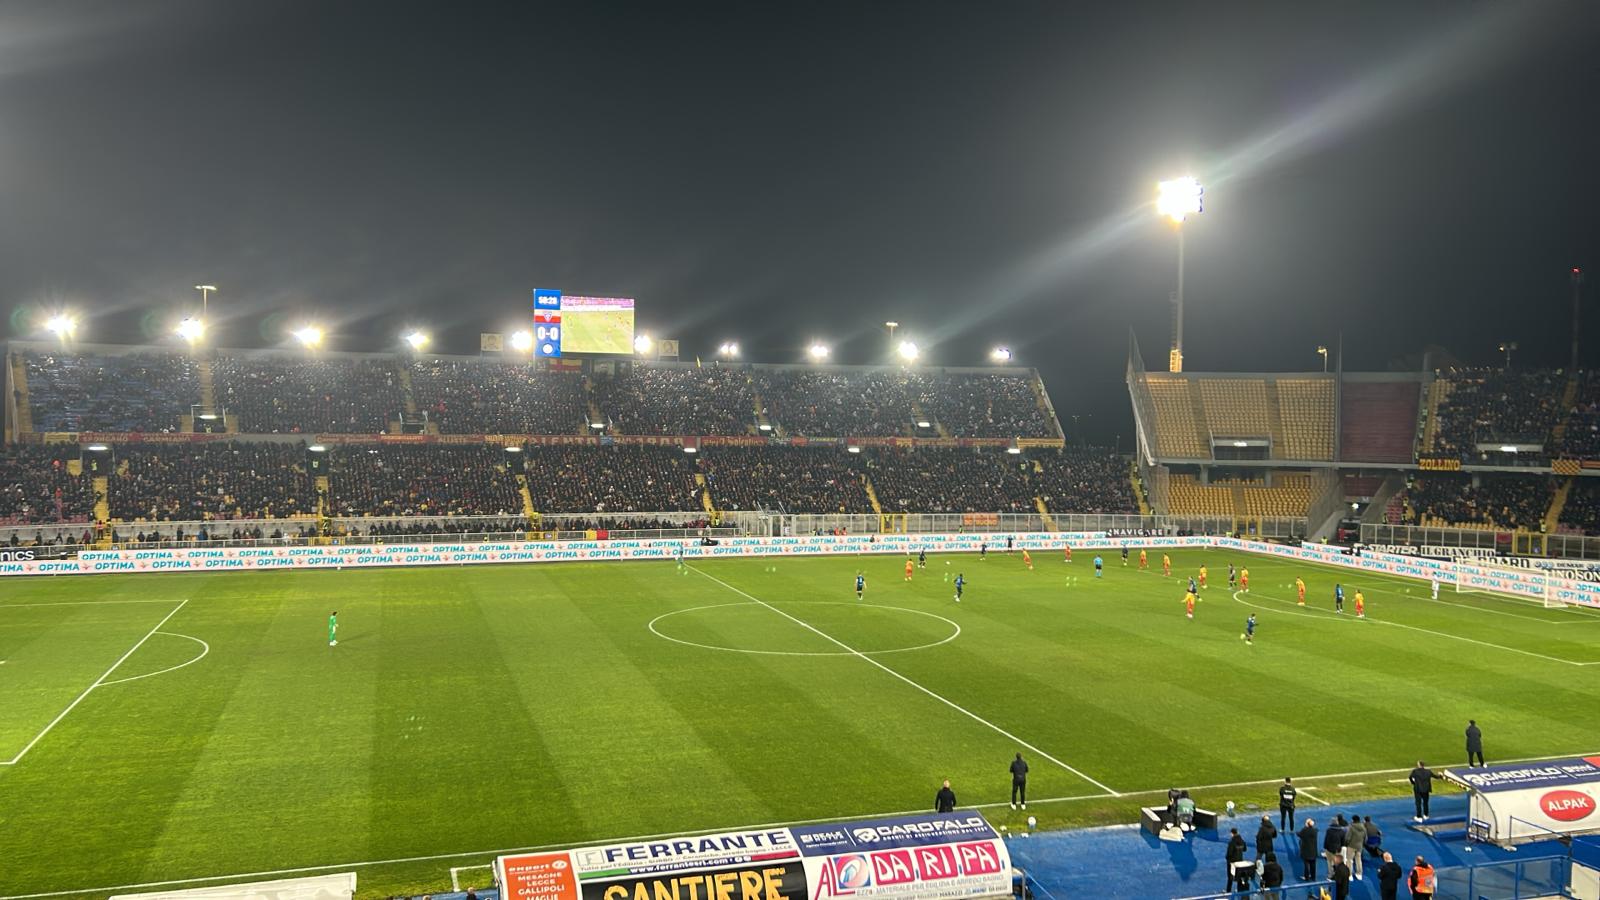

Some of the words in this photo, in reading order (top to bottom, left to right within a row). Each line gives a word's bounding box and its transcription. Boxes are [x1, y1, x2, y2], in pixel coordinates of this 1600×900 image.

[1418, 458, 1461, 471] ZOLLINO
[1113, 528, 1163, 536] NAVIGARE
[82, 551, 120, 560] OPTIMA
[136, 551, 173, 559] OPTIMA
[189, 550, 225, 558] OPTIMA
[239, 549, 273, 557] OPTIMA
[652, 540, 683, 548] OPTIMA
[1368, 543, 1419, 556] STARTER
[1433, 547, 1495, 558] GRANCHIO
[39, 562, 80, 572] OPTIMA
[95, 561, 135, 570] OPTIMA
[152, 560, 191, 568] OPTIMA
[205, 559, 243, 567] OPTIMA
[256, 557, 294, 566] OPTIMA
[307, 557, 344, 565] OPTIMA
[358, 555, 393, 564] OPTIMA
[406, 554, 441, 562] OPTIMA
[454, 553, 487, 561] OPTIMA
[500, 552, 532, 560] OPTIMA
[545, 551, 577, 559] OPTIMA
[589, 550, 621, 558] OPTIMA
[632, 549, 663, 557] OPTIMA
[672, 548, 703, 556] OTIMA
[713, 547, 743, 555] OPTIMA
[753, 546, 782, 554] OPTIMA
[1362, 559, 1387, 570] OPTIMA
[1548, 797, 1589, 811] ALPAK
[606, 830, 789, 862] FERRANTE
[517, 884, 566, 895] GALLIPOLI
[526, 879, 557, 887] LECCE
